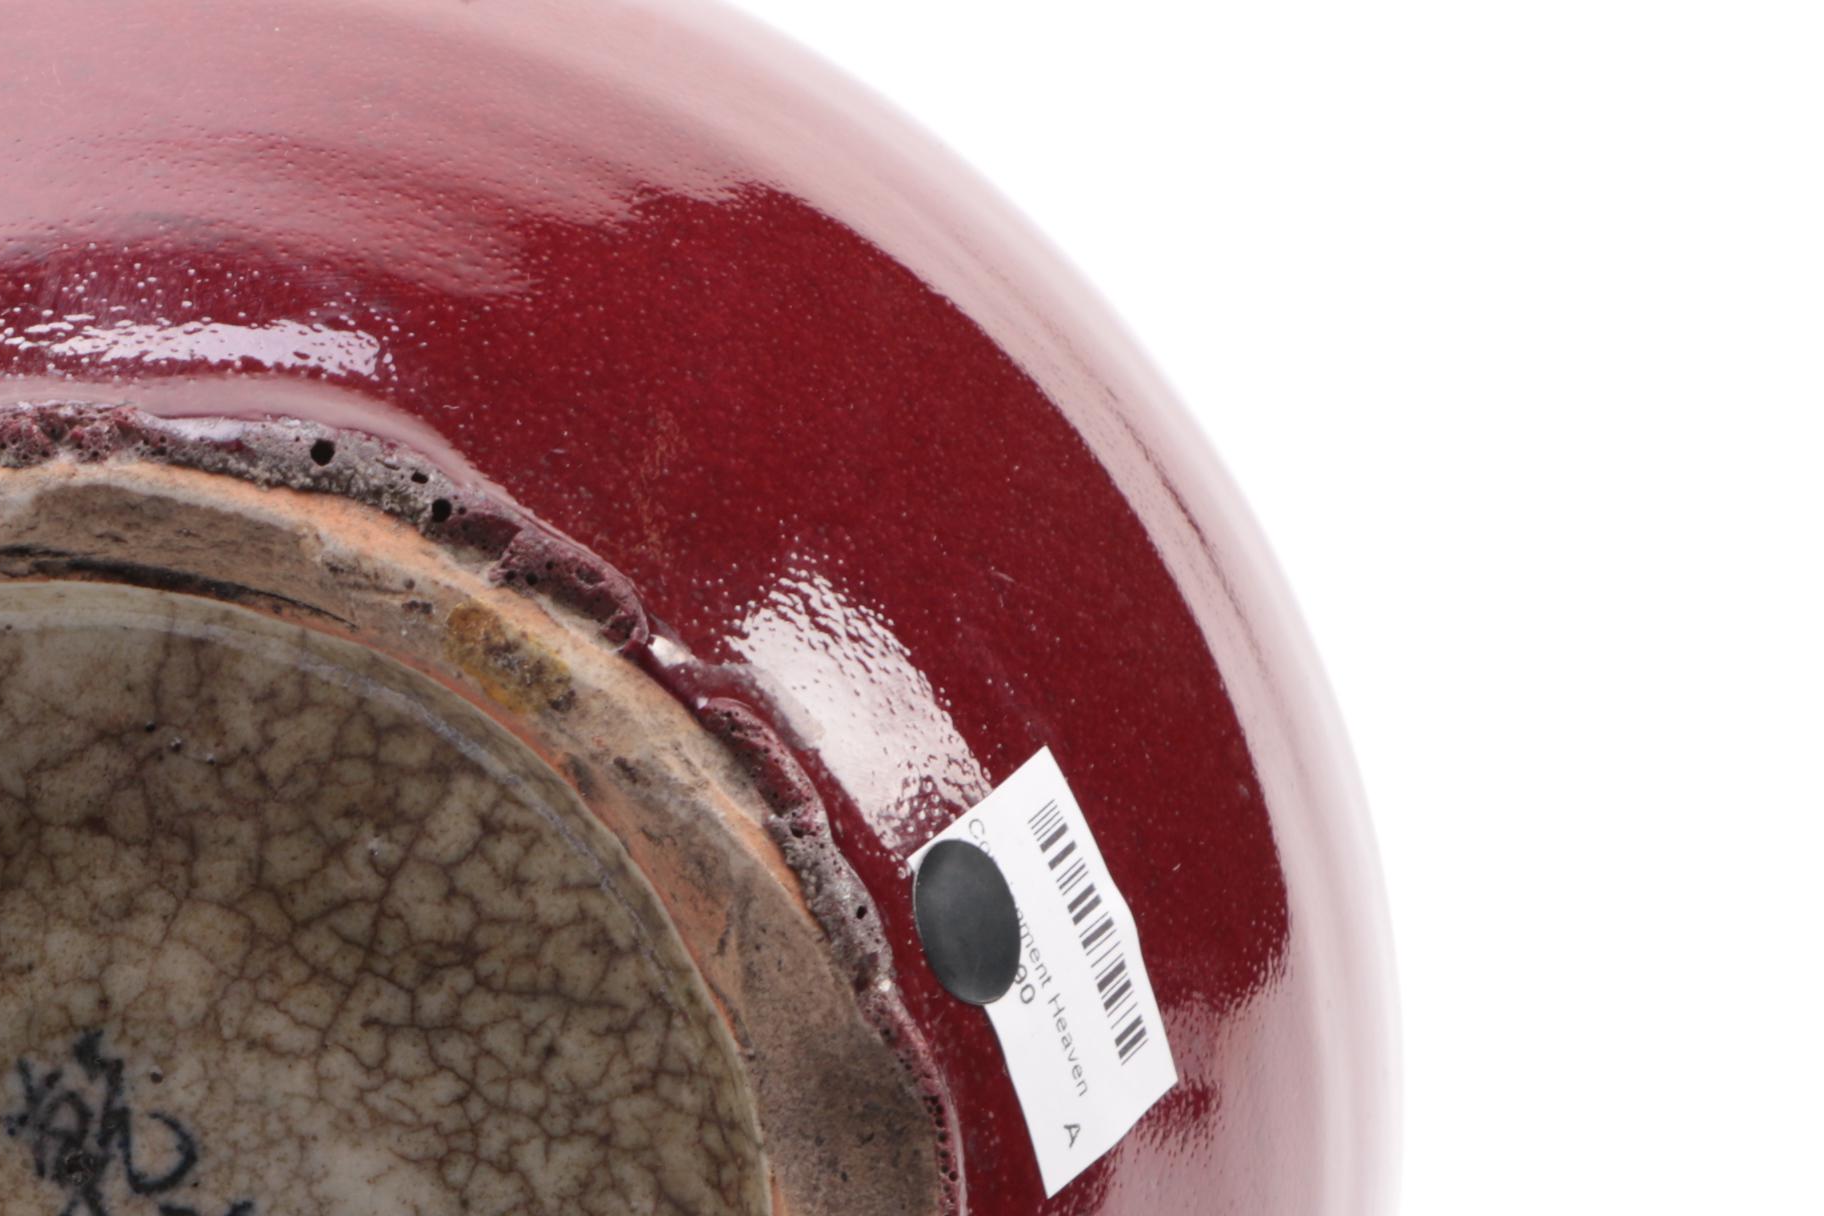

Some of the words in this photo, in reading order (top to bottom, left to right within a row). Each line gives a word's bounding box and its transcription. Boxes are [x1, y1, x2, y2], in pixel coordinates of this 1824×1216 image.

[969, 818, 1052, 988] Coment
[1047, 992, 1089, 1097] Heaven
[1063, 1123, 1081, 1148] A
